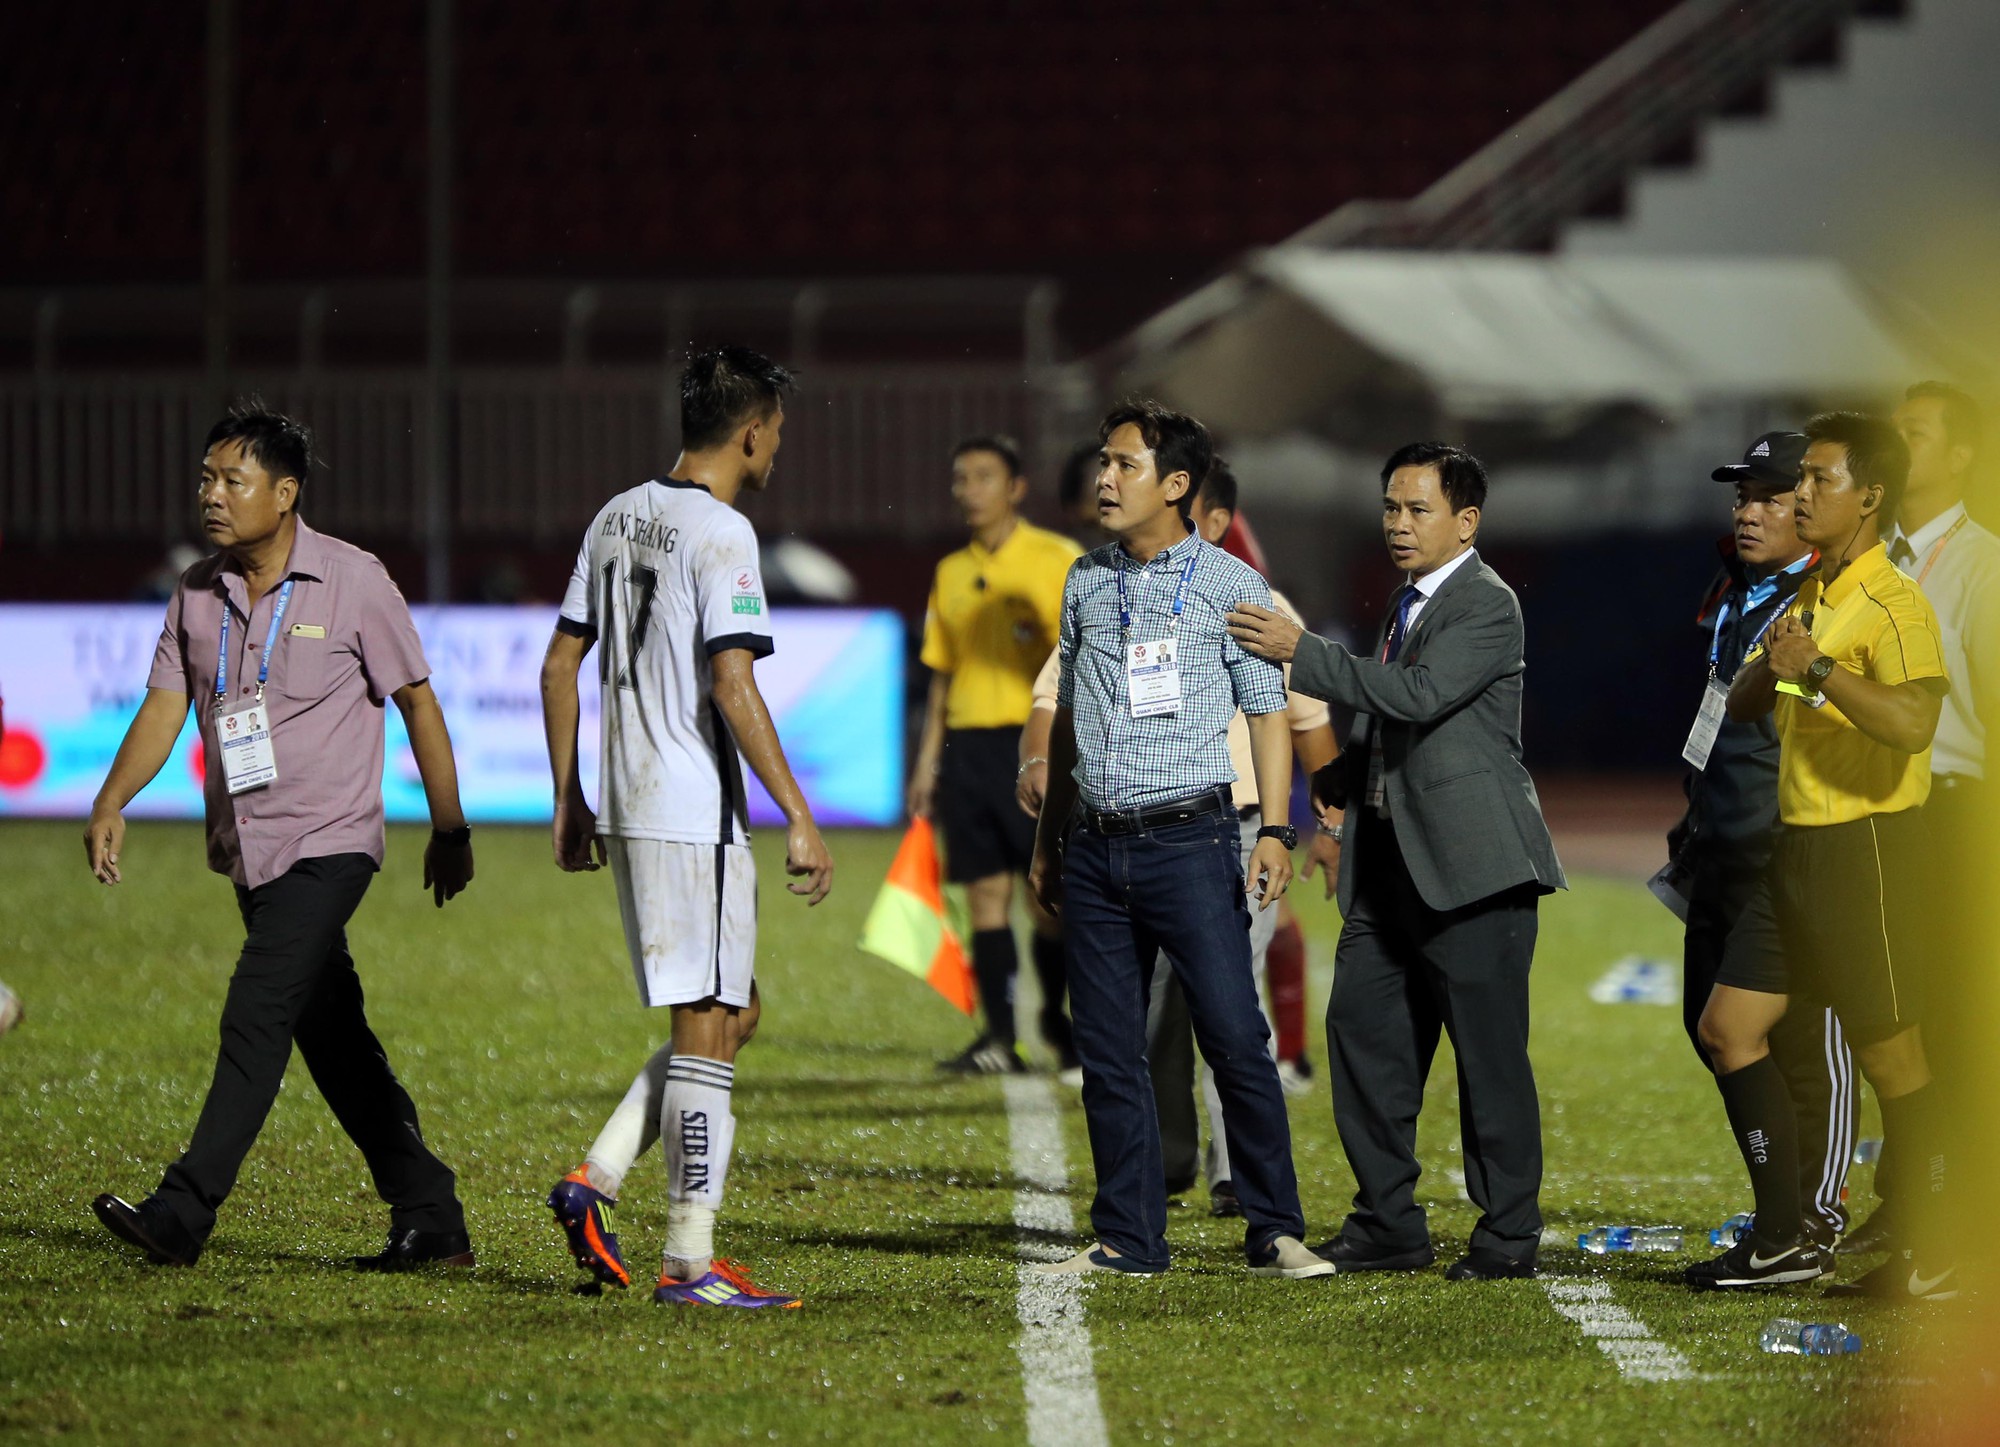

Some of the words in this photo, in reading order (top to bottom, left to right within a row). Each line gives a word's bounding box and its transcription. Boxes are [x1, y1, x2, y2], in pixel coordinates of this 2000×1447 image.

[733, 598, 760, 608] NUTI
[601, 556, 659, 689] 17
[1159, 663, 1177, 672] 2018
[1169, 703, 1179, 711] CLB
[251, 731, 268, 742] 2018
[680, 1110, 708, 1157] SHB
[1747, 1129, 1769, 1164] mitre
[1929, 1153, 1947, 1193] mitre
